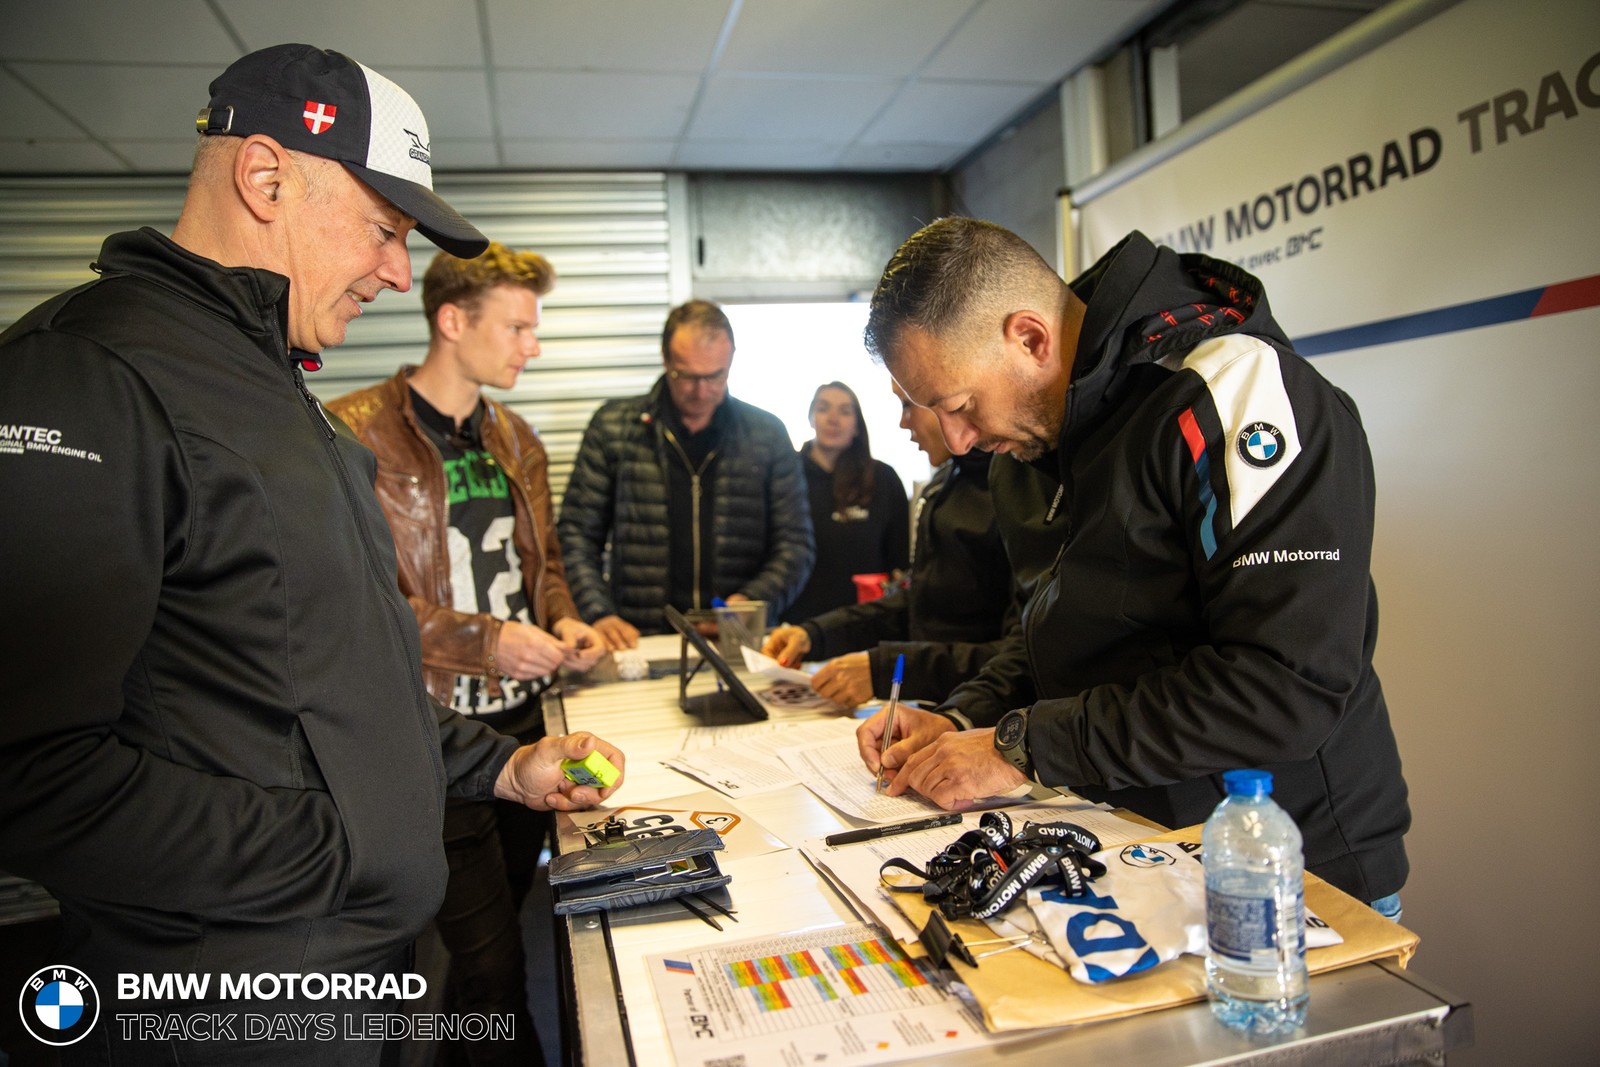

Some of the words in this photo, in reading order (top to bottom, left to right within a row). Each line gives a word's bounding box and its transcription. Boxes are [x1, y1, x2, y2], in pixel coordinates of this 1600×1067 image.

[1225, 127, 1443, 243] MOTORRAD
[0, 424, 62, 445] ANTEC
[26, 441, 51, 453] BMW
[51, 445, 87, 459] ENGINE
[87, 452, 103, 462] OIL
[1232, 550, 1270, 568] BMW
[1273, 548, 1341, 564] Motorrad
[1021, 852, 1048, 884] BMW
[1061, 856, 1083, 891] BMW
